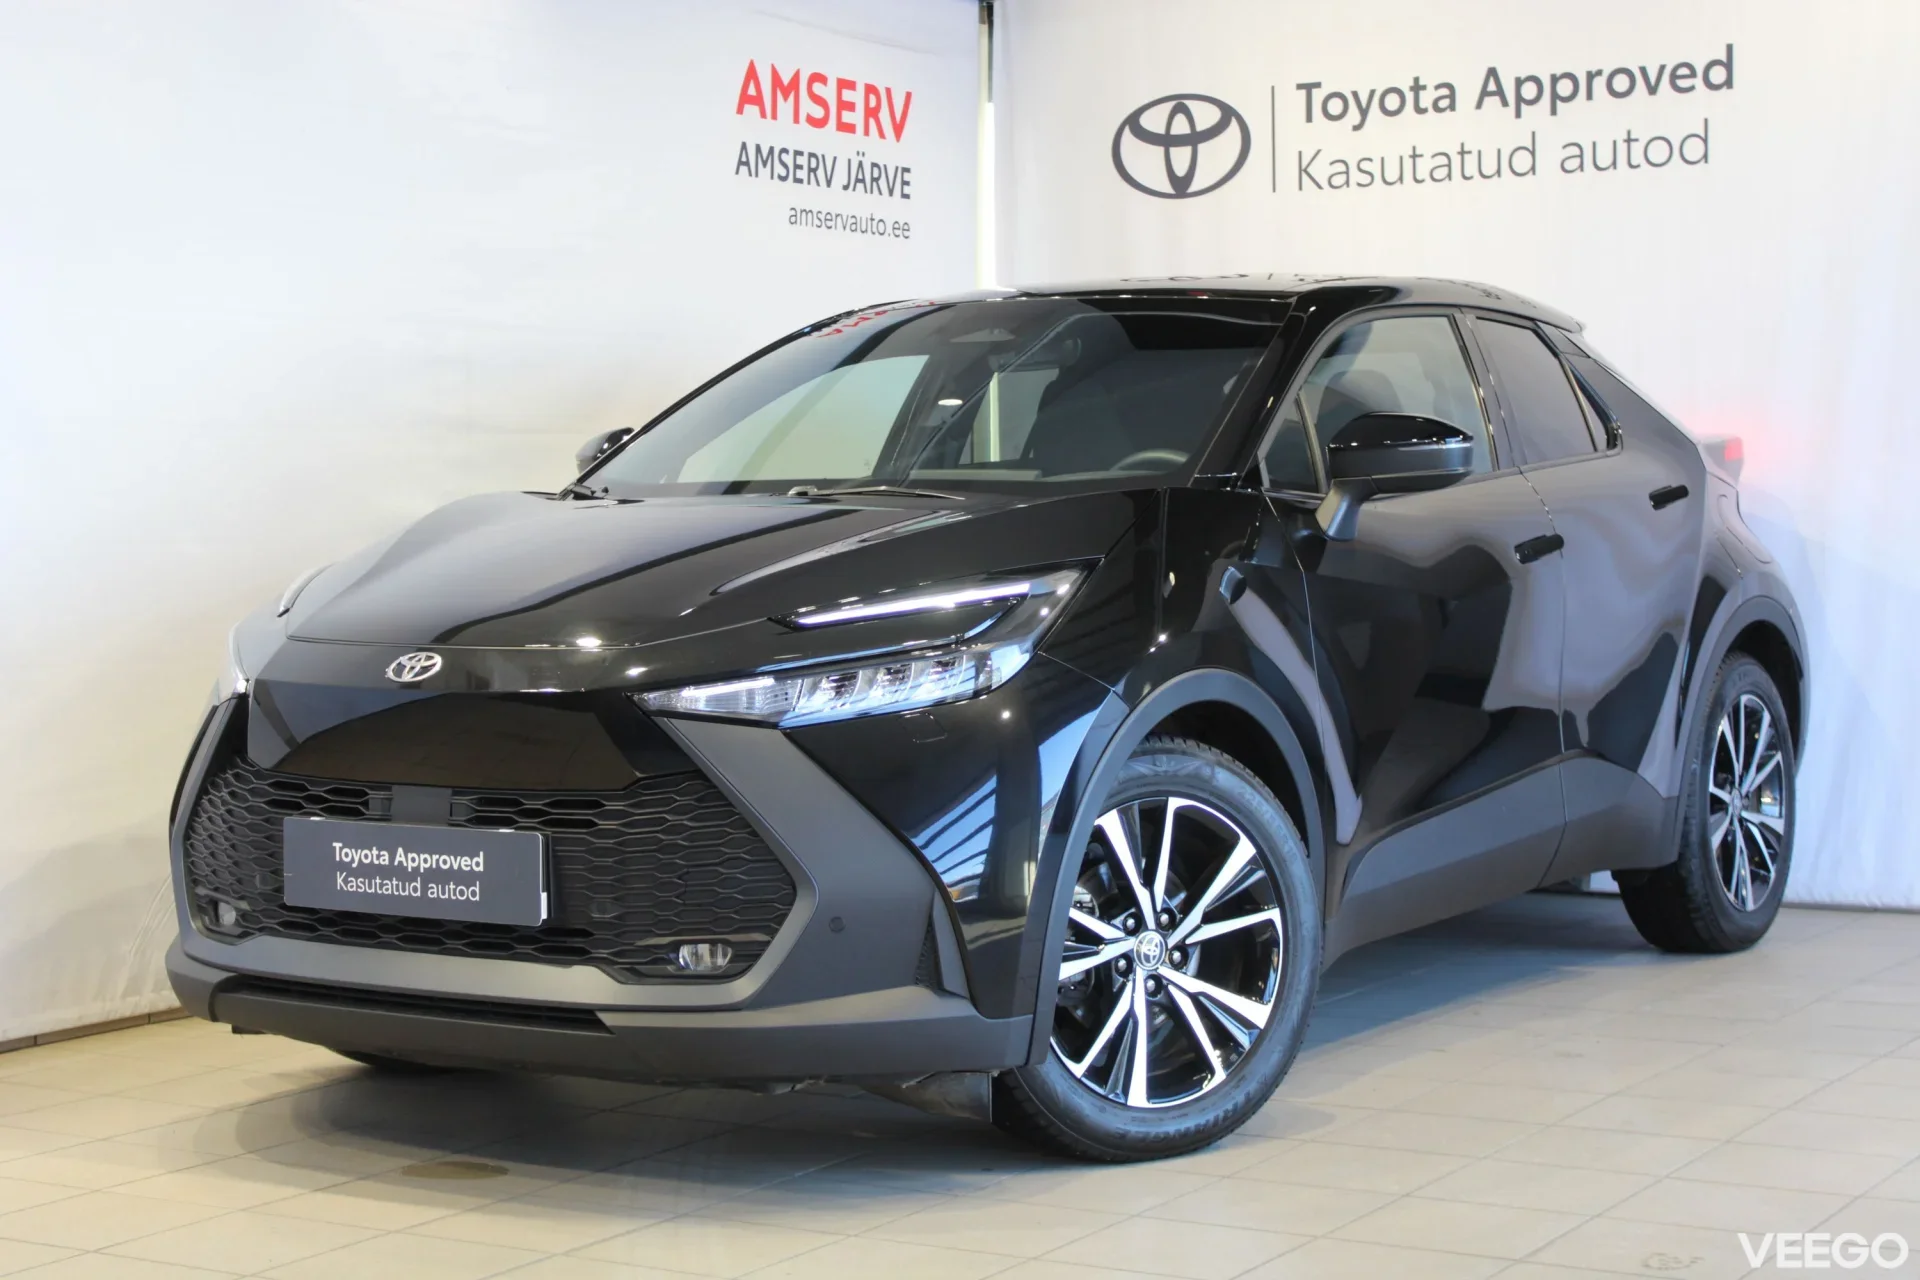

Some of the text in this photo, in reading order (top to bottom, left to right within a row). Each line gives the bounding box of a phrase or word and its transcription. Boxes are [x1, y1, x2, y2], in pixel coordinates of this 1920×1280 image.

[735, 59, 913, 143] AMSERV
[1295, 44, 1734, 132] Toyota Approved
[735, 141, 912, 200] AMSERV JÄRVE
[1297, 118, 1710, 192] Kasutatud autod
[788, 206, 911, 240] amservauto.ee
[332, 842, 484, 873] Toyota Approved
[336, 871, 480, 902] Kasutatud autod
